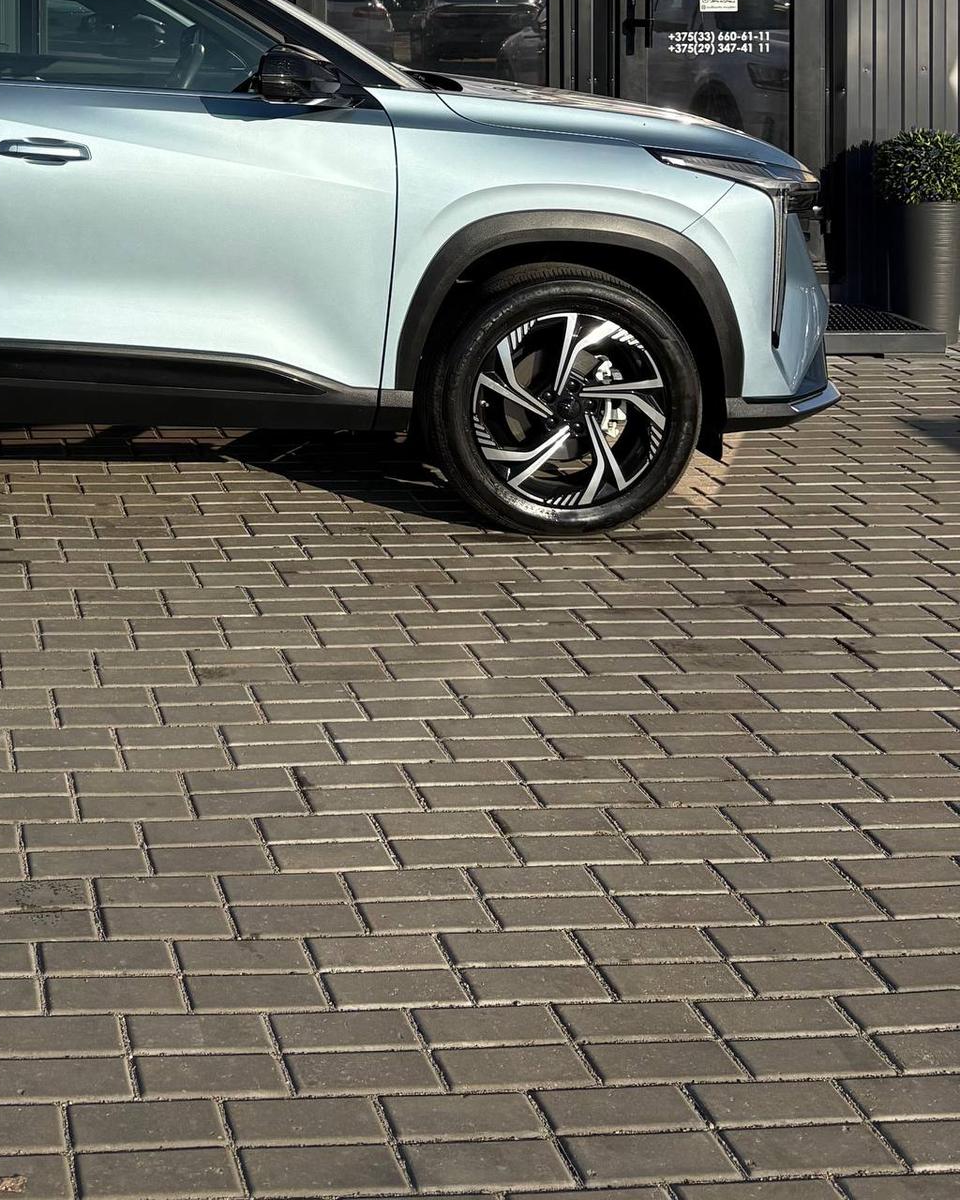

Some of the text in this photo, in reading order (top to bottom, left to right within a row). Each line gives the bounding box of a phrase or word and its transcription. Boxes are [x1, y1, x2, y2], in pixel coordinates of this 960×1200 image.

[668, 31, 770, 44] +375(33) 660-61-11
[668, 43, 715, 55] +375(29)
